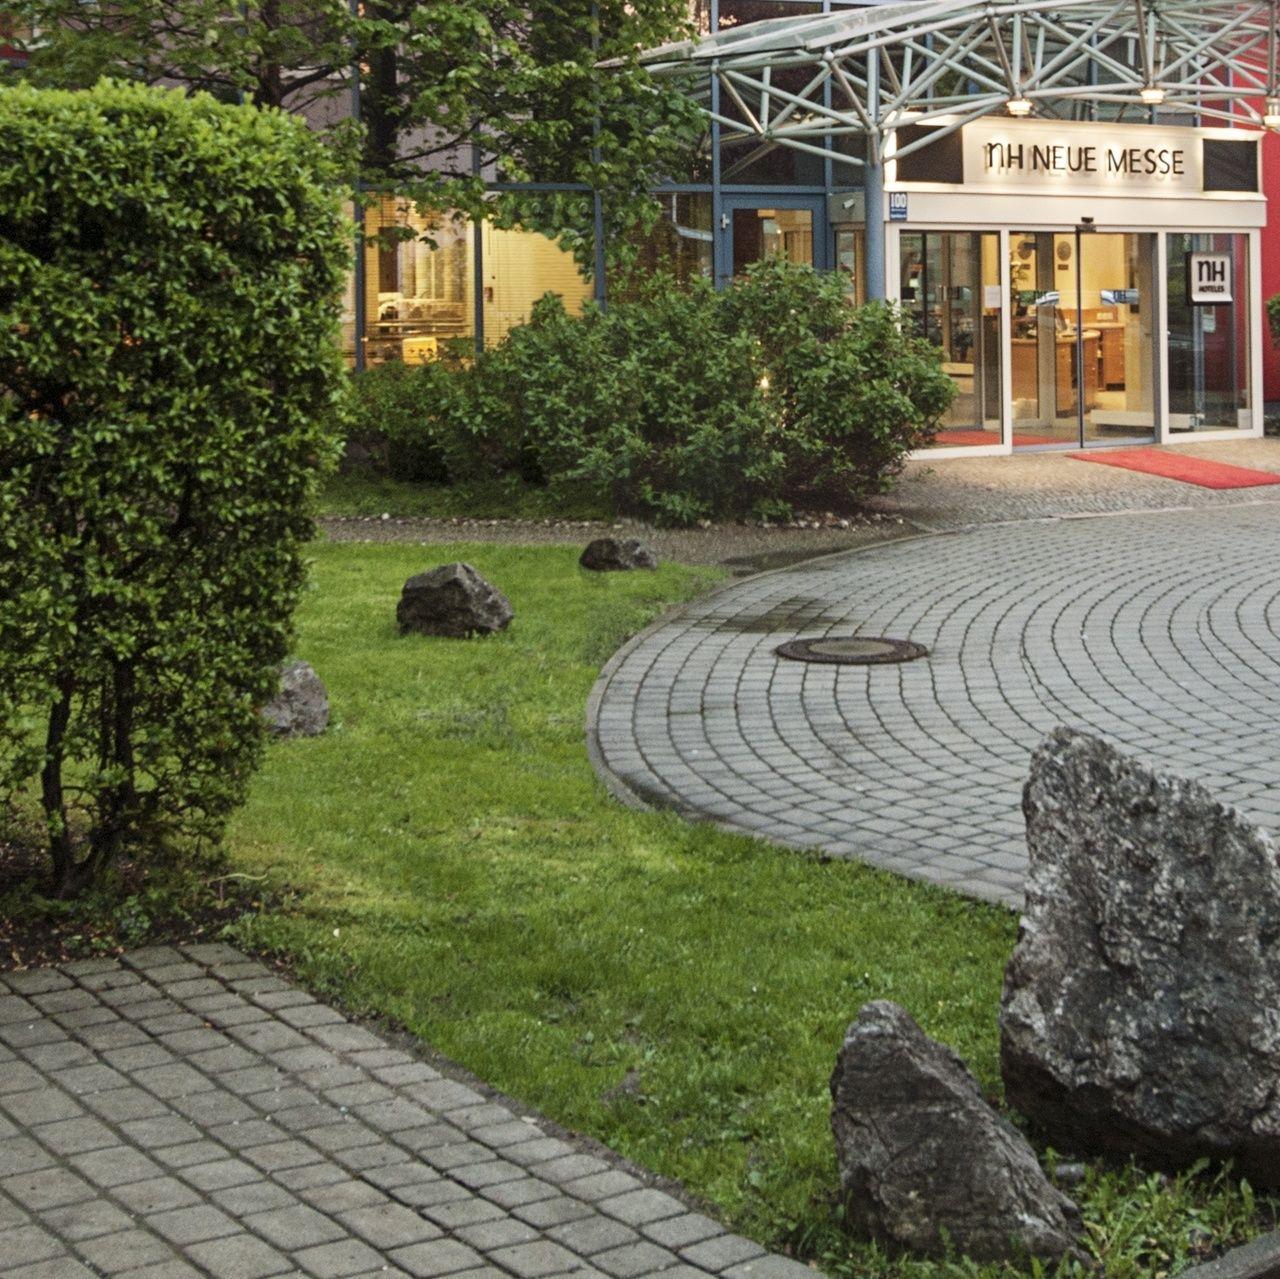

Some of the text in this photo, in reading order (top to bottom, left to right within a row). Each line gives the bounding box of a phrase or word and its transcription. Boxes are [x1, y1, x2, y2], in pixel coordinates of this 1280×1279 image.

[1032, 144, 1097, 172] NEUE
[1108, 148, 1185, 174] MESSE
[891, 193, 907, 208] 100
[1199, 285, 1225, 293] HOTELES
